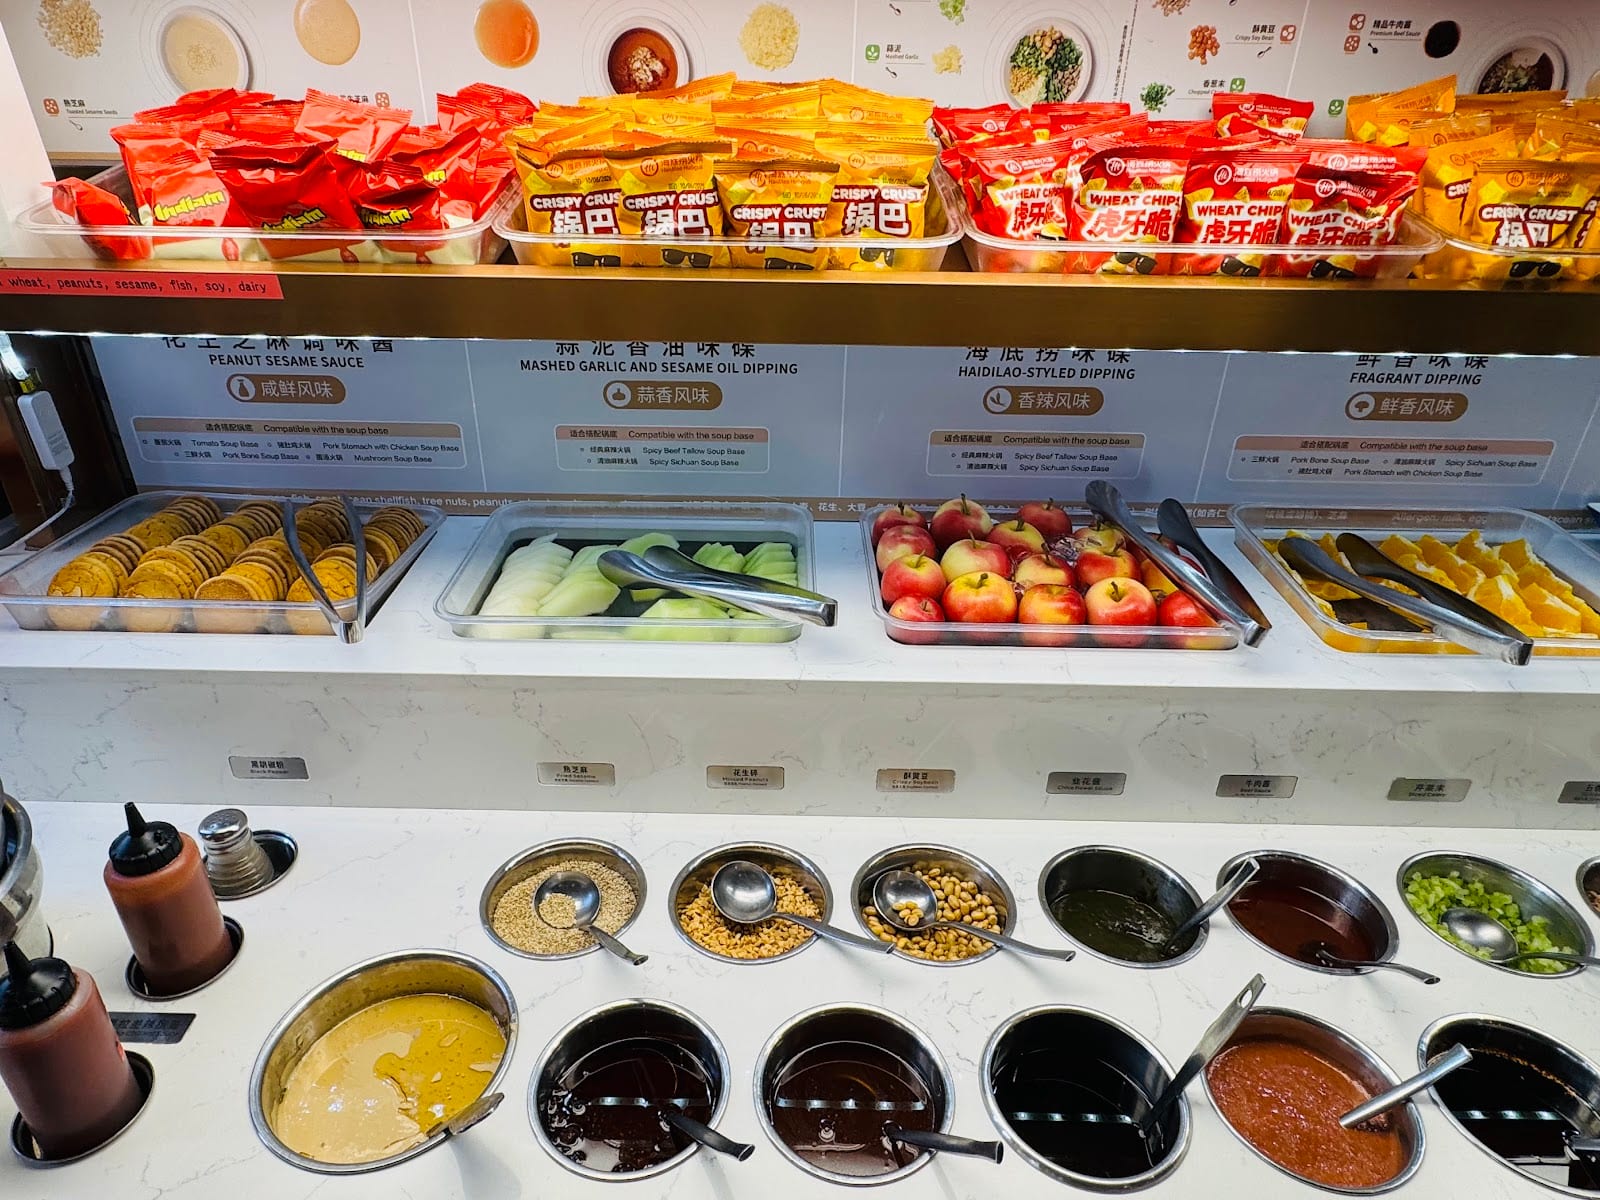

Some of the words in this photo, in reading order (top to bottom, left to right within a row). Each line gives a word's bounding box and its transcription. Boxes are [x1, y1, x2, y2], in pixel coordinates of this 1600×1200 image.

[1235, 33, 1251, 41] Crispy
[1252, 33, 1261, 41] Soy
[625, 194, 677, 210] CRISPY
[679, 191, 719, 206] CRUST
[831, 188, 880, 201] CRISPY
[881, 188, 925, 201] CRUST
[1000, 188, 1040, 201] WHEAT
[1090, 194, 1140, 207] WHEAT
[533, 197, 583, 209] CRISPY
[733, 207, 782, 220] CRISPY
[784, 207, 828, 220] CRUST
[1197, 205, 1245, 217] WHEAT
[1482, 207, 1527, 221] CRISPY
[1528, 208, 1579, 222] CRUST
[553, 209, 619, 236] 锅巴
[645, 209, 711, 237] 锅巴
[844, 201, 910, 236] 锅巴
[1087, 208, 1172, 241] 虎牙脆
[1291, 213, 1342, 226] WHEAT
[1343, 216, 1389, 231] CHIPS
[1200, 219, 1278, 245] 虎牙脆
[9, 276, 51, 289] wheat,
[57, 278, 109, 291] peanuts,
[115, 280, 164, 292] sesame,
[170, 279, 198, 293] fish,
[205, 281, 232, 294] soy,
[238, 280, 267, 294] dairy
[208, 354, 262, 366] PEANUT
[265, 355, 318, 367] SESAME
[321, 356, 364, 369] SAUCE
[520, 359, 576, 372] MASHED
[579, 361, 627, 373] GARLIC
[631, 361, 657, 373] AND
[661, 362, 714, 374] SESAME
[717, 363, 739, 375] OIL
[743, 363, 799, 375] DIPPING
[958, 366, 1076, 379] HAIDILAO-STYLED
[1079, 368, 1136, 380] DIPPING
[1350, 372, 1423, 384] FRAGRANT
[1424, 373, 1482, 385] DIPPING
[261, 380, 333, 399] 咸鲜风味
[637, 386, 710, 404] 蒜香风味
[1018, 391, 1091, 409] 香辣风味
[1378, 397, 1455, 416] 鲜香风味
[263, 424, 310, 434] Compatible
[346, 427, 366, 435] soup
[368, 426, 389, 434] base
[570, 430, 618, 438] 适合搭配锅底
[628, 431, 675, 440] Compatible
[676, 431, 695, 439] with
[696, 432, 709, 440] the
[711, 432, 732, 441] soup
[733, 432, 754, 440] base
[944, 434, 993, 443] 适合搭配锅底
[1003, 435, 1050, 445] Compatible
[1052, 436, 1070, 444] with
[1071, 436, 1085, 444] the
[1087, 437, 1107, 446] soup
[1109, 437, 1130, 445] base
[221, 441, 239, 449] Soup
[341, 442, 373, 450] Stomach
[390, 443, 419, 451] Chicken
[420, 444, 439, 452] Soup
[1360, 441, 1407, 451] Compatible
[1428, 443, 1442, 451] the
[1444, 444, 1466, 452] soup
[222, 451, 240, 459] Pork
[642, 447, 662, 455] Spicy
[706, 448, 725, 456] Soup
[1014, 452, 1034, 461] Spicy
[1035, 452, 1053, 460] Beef
[1079, 453, 1098, 462] Soup
[354, 454, 393, 462] Mushroom
[394, 455, 412, 463] Soup
[414, 455, 433, 463] Base
[649, 458, 668, 466] Spicy
[701, 459, 719, 467] Soup
[1291, 456, 1308, 464] Pork
[1330, 457, 1350, 465] Soup
[1445, 459, 1466, 467] Spicy
[1466, 459, 1496, 467] Sichuan
[1497, 460, 1517, 468] Soup
[1019, 464, 1040, 472] Spicy
[1071, 464, 1090, 473] Soup
[1363, 468, 1395, 476] Stomach
[1443, 470, 1463, 478] Soup
[422, 497, 443, 506] tree
[445, 498, 471, 507] nuts,
[733, 769, 758, 777] 花生碎
